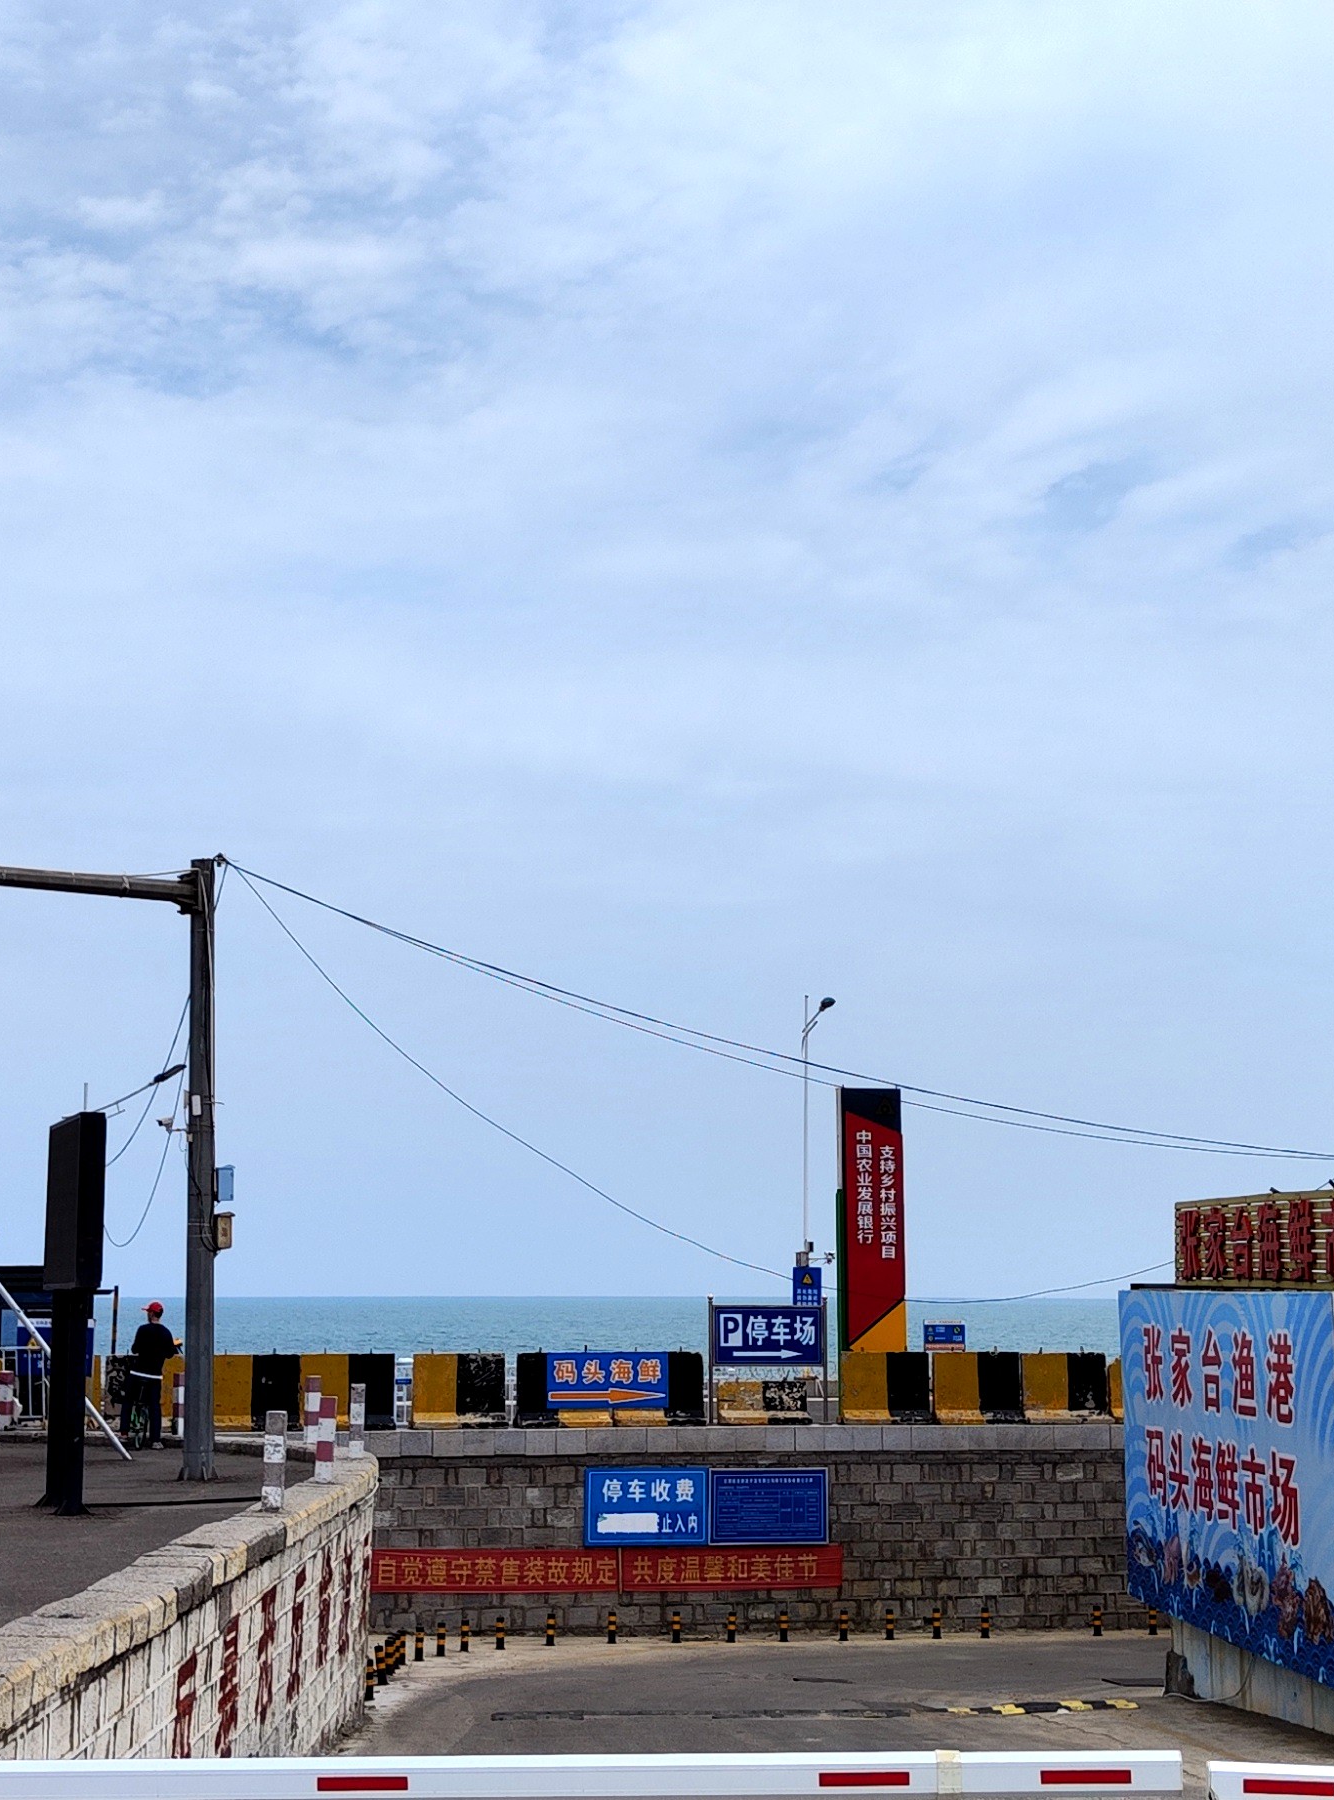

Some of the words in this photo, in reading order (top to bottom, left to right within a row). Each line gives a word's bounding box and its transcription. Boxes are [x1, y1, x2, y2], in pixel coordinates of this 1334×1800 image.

[855, 1129, 874, 1245] 中国农业发展银行
[879, 1145, 898, 1260] 支持乡村振兴项目
[745, 1314, 817, 1346] 停车场
[553, 1360, 662, 1384] 码头海鲜
[1142, 1324, 1295, 1425] 张家台渔港
[602, 1478, 695, 1503] 停车收费
[1144, 1427, 1301, 1548] 码头海鲜市场
[656, 1512, 699, 1534] 止入内
